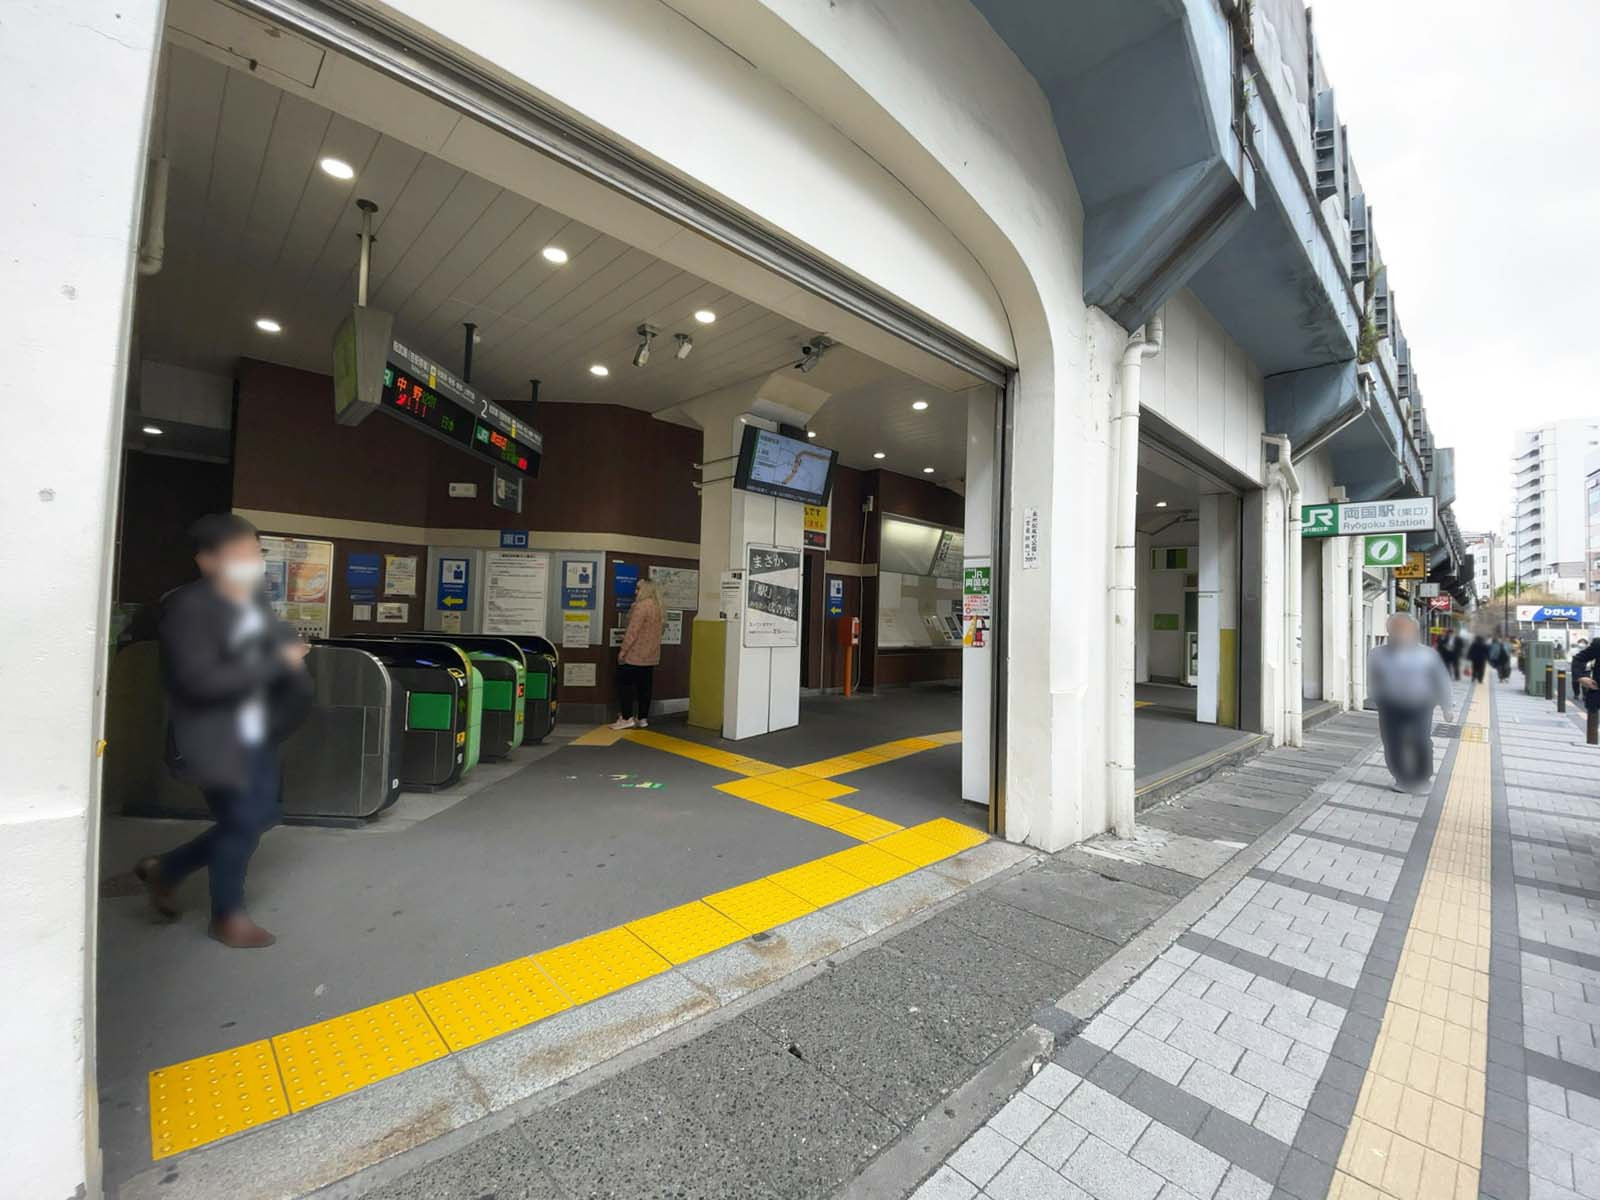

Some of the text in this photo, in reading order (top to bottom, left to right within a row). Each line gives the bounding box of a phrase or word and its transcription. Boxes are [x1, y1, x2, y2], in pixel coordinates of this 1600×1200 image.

[480, 399, 488, 418] 2
[1302, 508, 1334, 527] JR
[1389, 518, 1426, 528] Station
[753, 554, 788, 569] まさか、
[972, 569, 983, 579] JR
